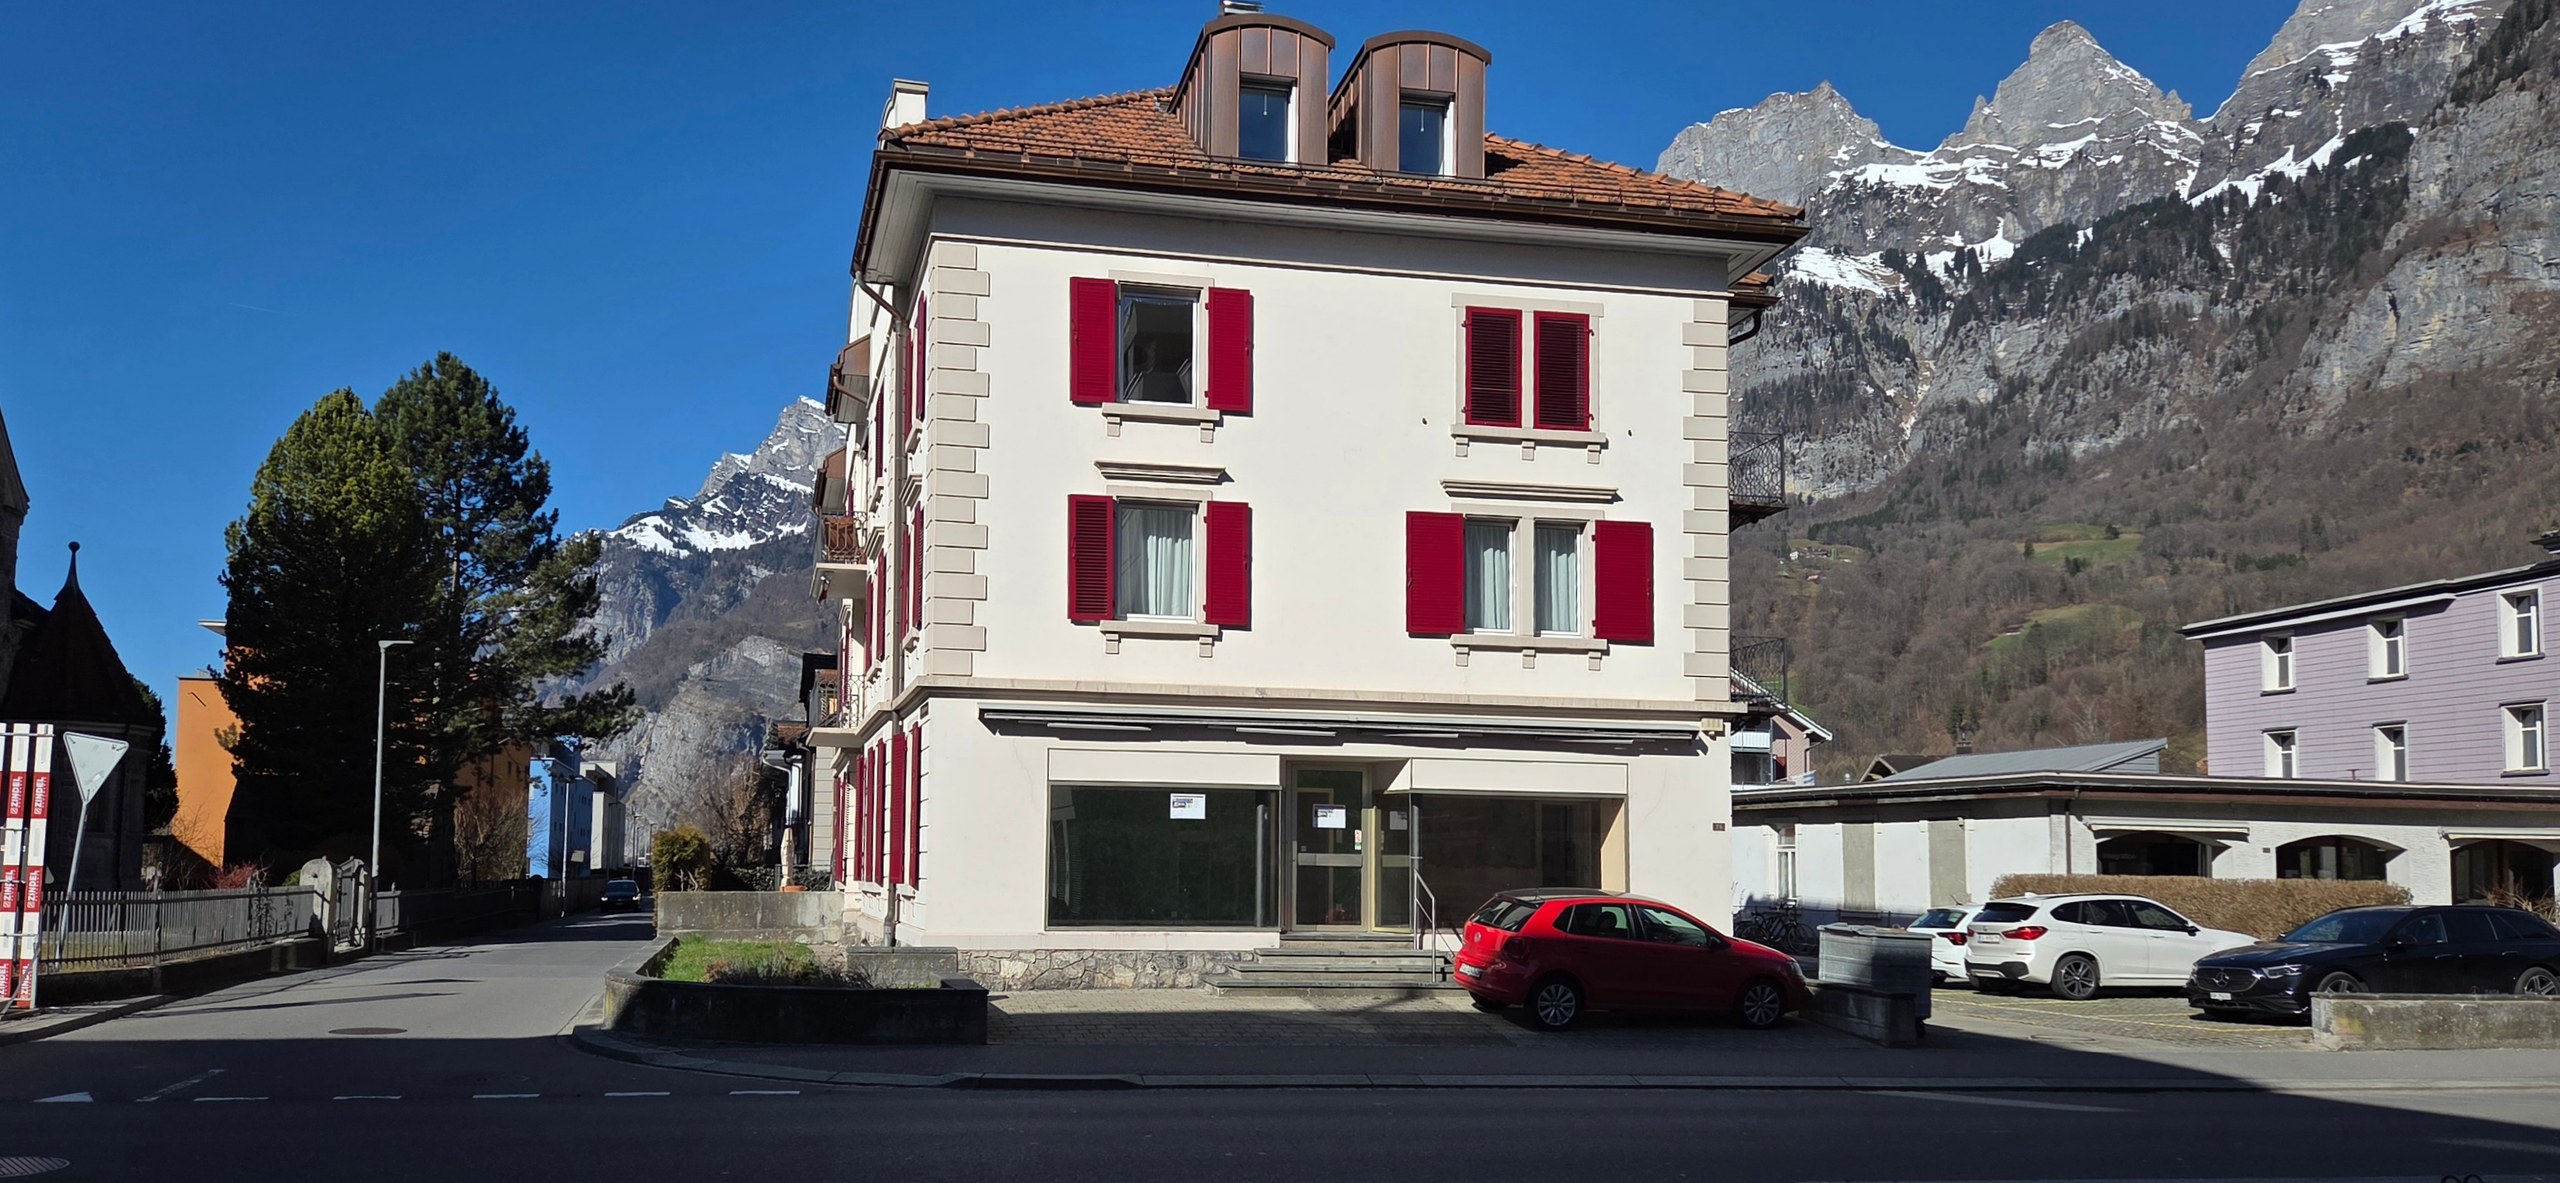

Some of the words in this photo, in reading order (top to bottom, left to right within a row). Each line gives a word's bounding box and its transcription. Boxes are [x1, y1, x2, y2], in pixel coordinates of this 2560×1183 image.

[11, 776, 20, 808] ZINDEL
[35, 777, 44, 808] ZINDEL
[28, 870, 38, 902] ZINDEL
